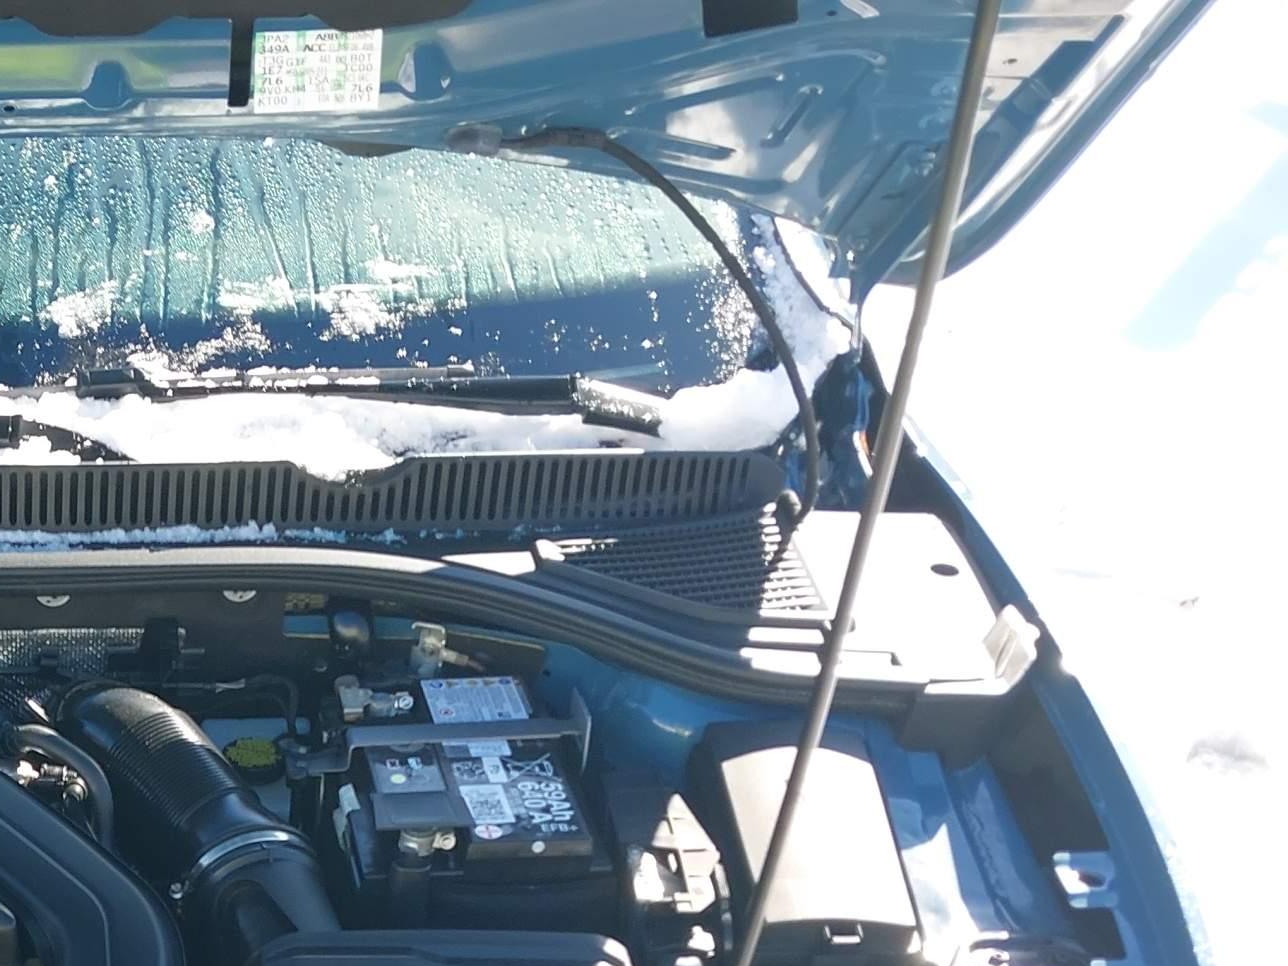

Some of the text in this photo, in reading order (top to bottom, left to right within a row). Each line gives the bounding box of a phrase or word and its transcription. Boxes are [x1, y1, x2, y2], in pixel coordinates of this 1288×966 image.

[518, 781, 548, 809] 640
[540, 781, 575, 822] 59Ah
[528, 811, 553, 824] A
